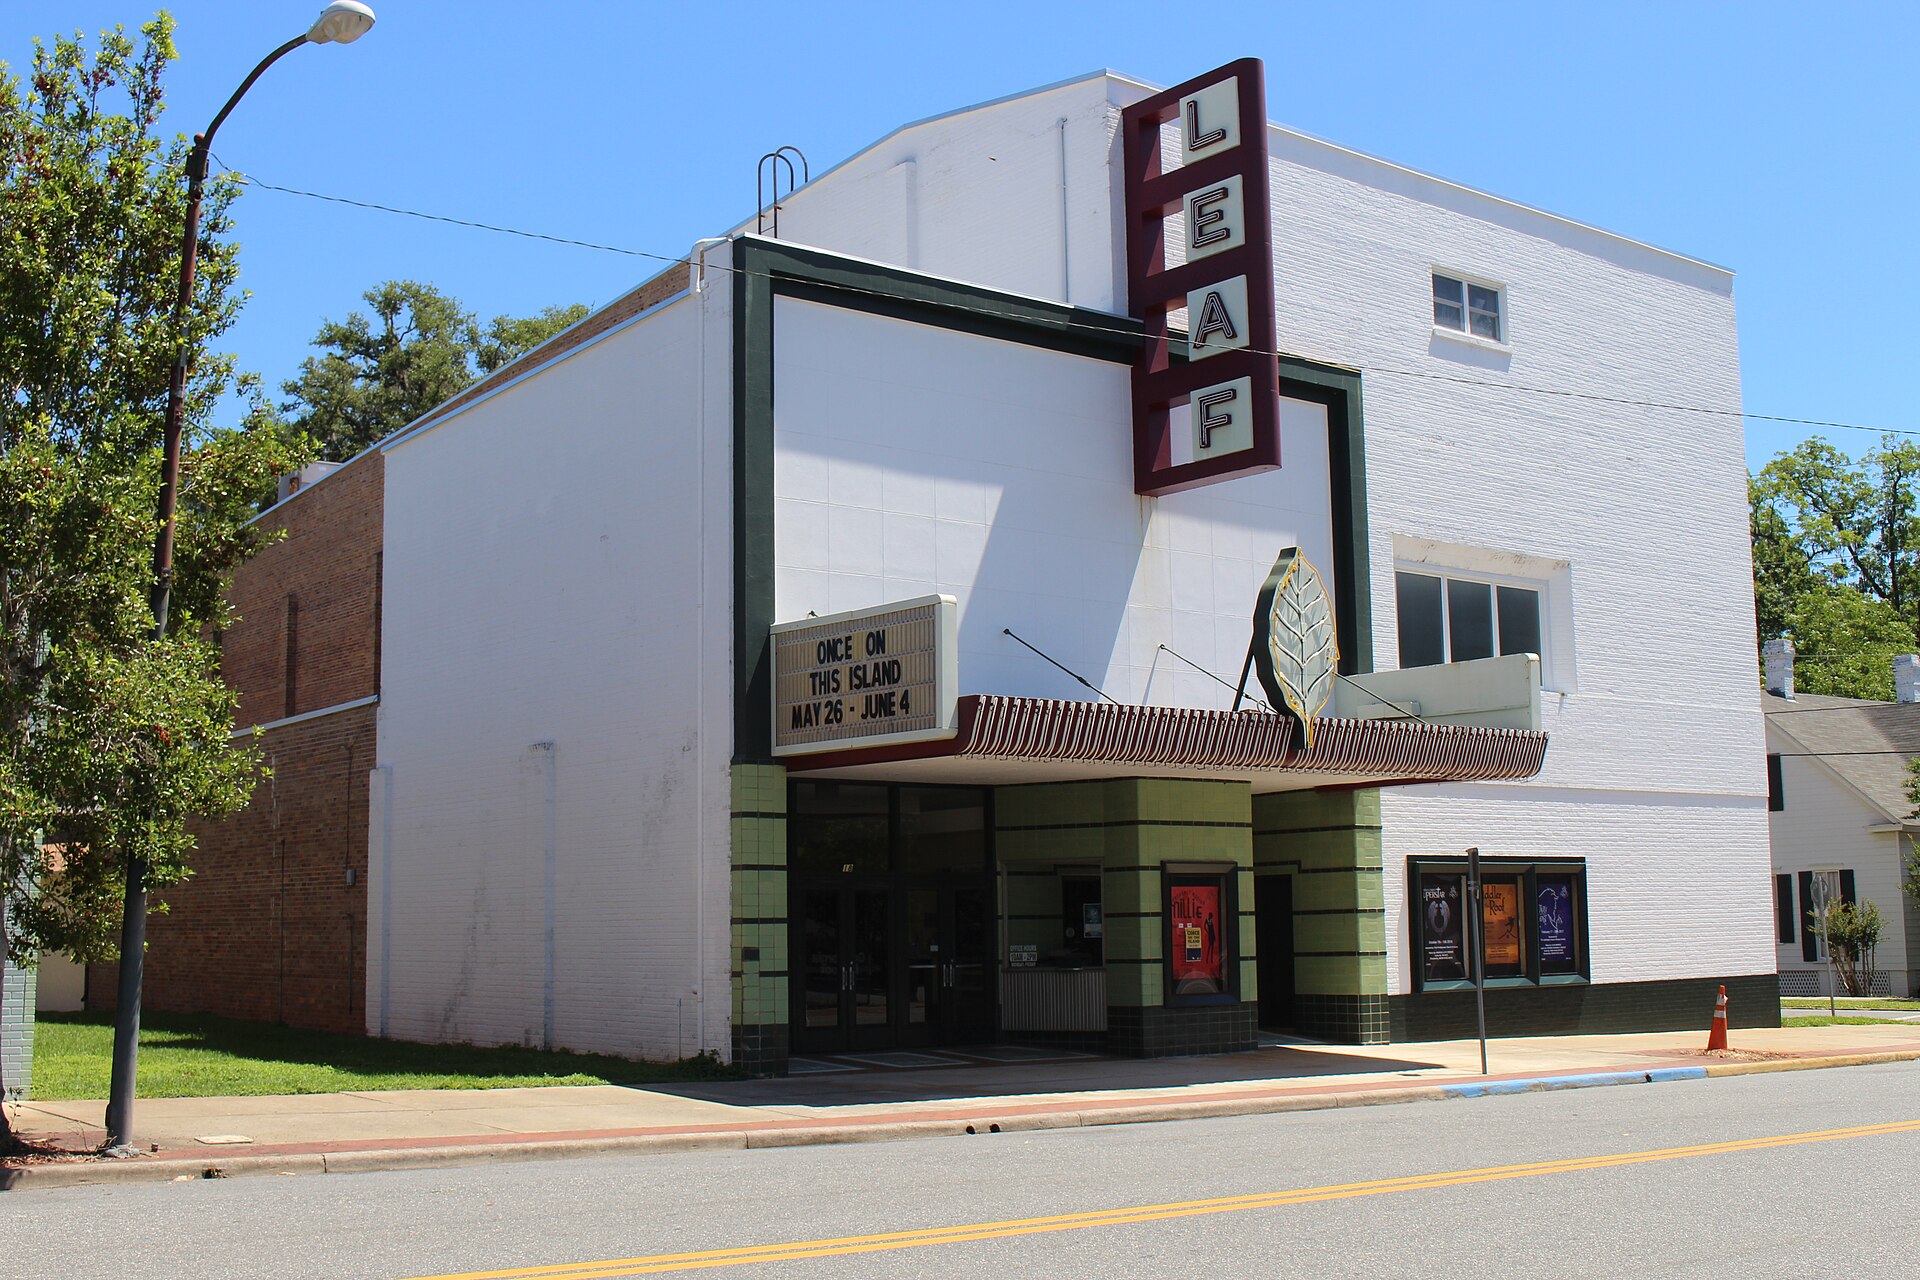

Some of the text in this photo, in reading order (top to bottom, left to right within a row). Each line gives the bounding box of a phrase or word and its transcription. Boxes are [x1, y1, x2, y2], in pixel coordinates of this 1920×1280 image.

[1187, 100, 1237, 448] LEAF
[817, 629, 886, 665] ONCE ON
[810, 660, 902, 696] THIS ISLAND
[791, 702, 821, 730] MAY
[824, 699, 843, 725] 26
[861, 691, 896, 720] JUNE
[900, 689, 910, 715] 4
